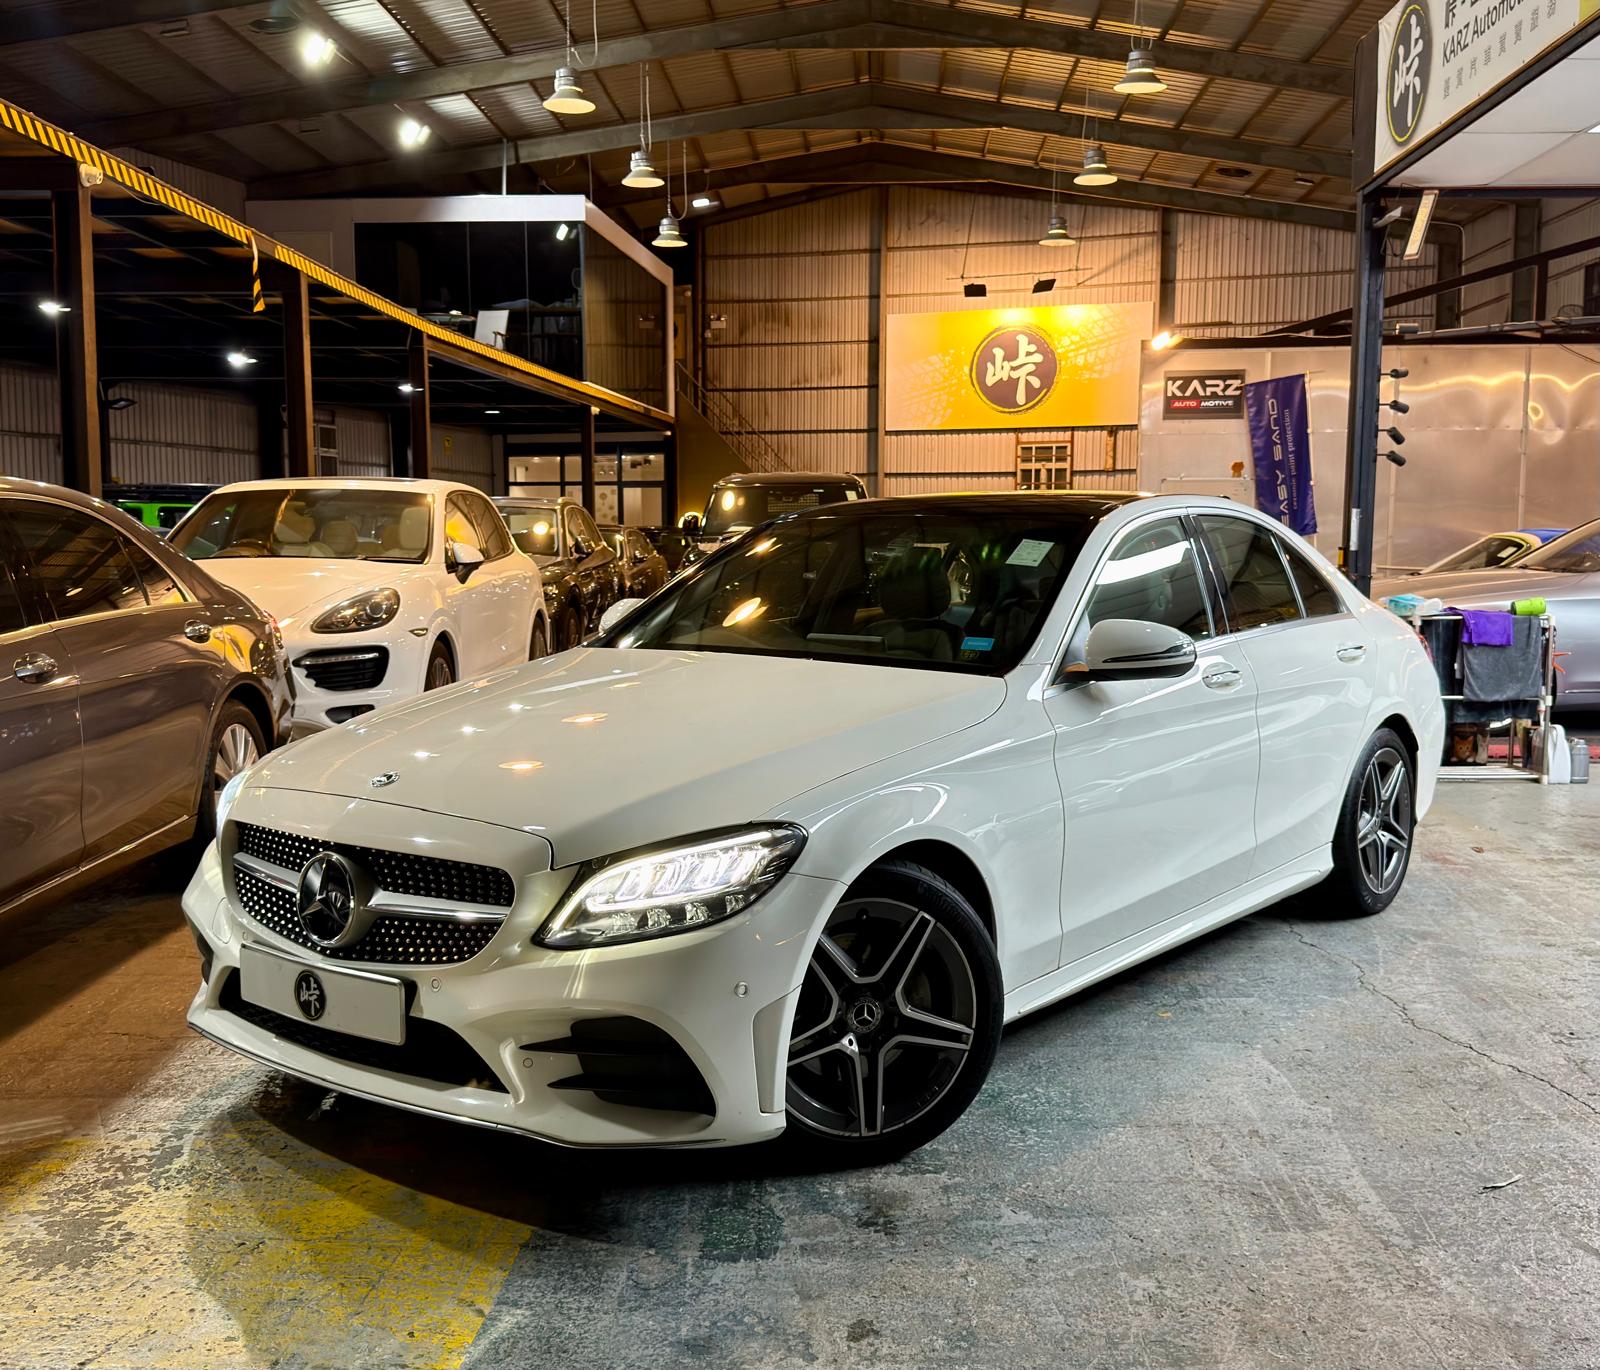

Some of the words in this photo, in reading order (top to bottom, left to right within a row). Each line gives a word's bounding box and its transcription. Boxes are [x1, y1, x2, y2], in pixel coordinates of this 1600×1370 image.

[1442, 21, 1470, 67] KARZ
[985, 333, 1044, 406] 峠
[1166, 379, 1242, 396] KARZ
[1268, 398, 1283, 462] SAND
[1284, 408, 1296, 452] protection
[1288, 453, 1297, 476] paint
